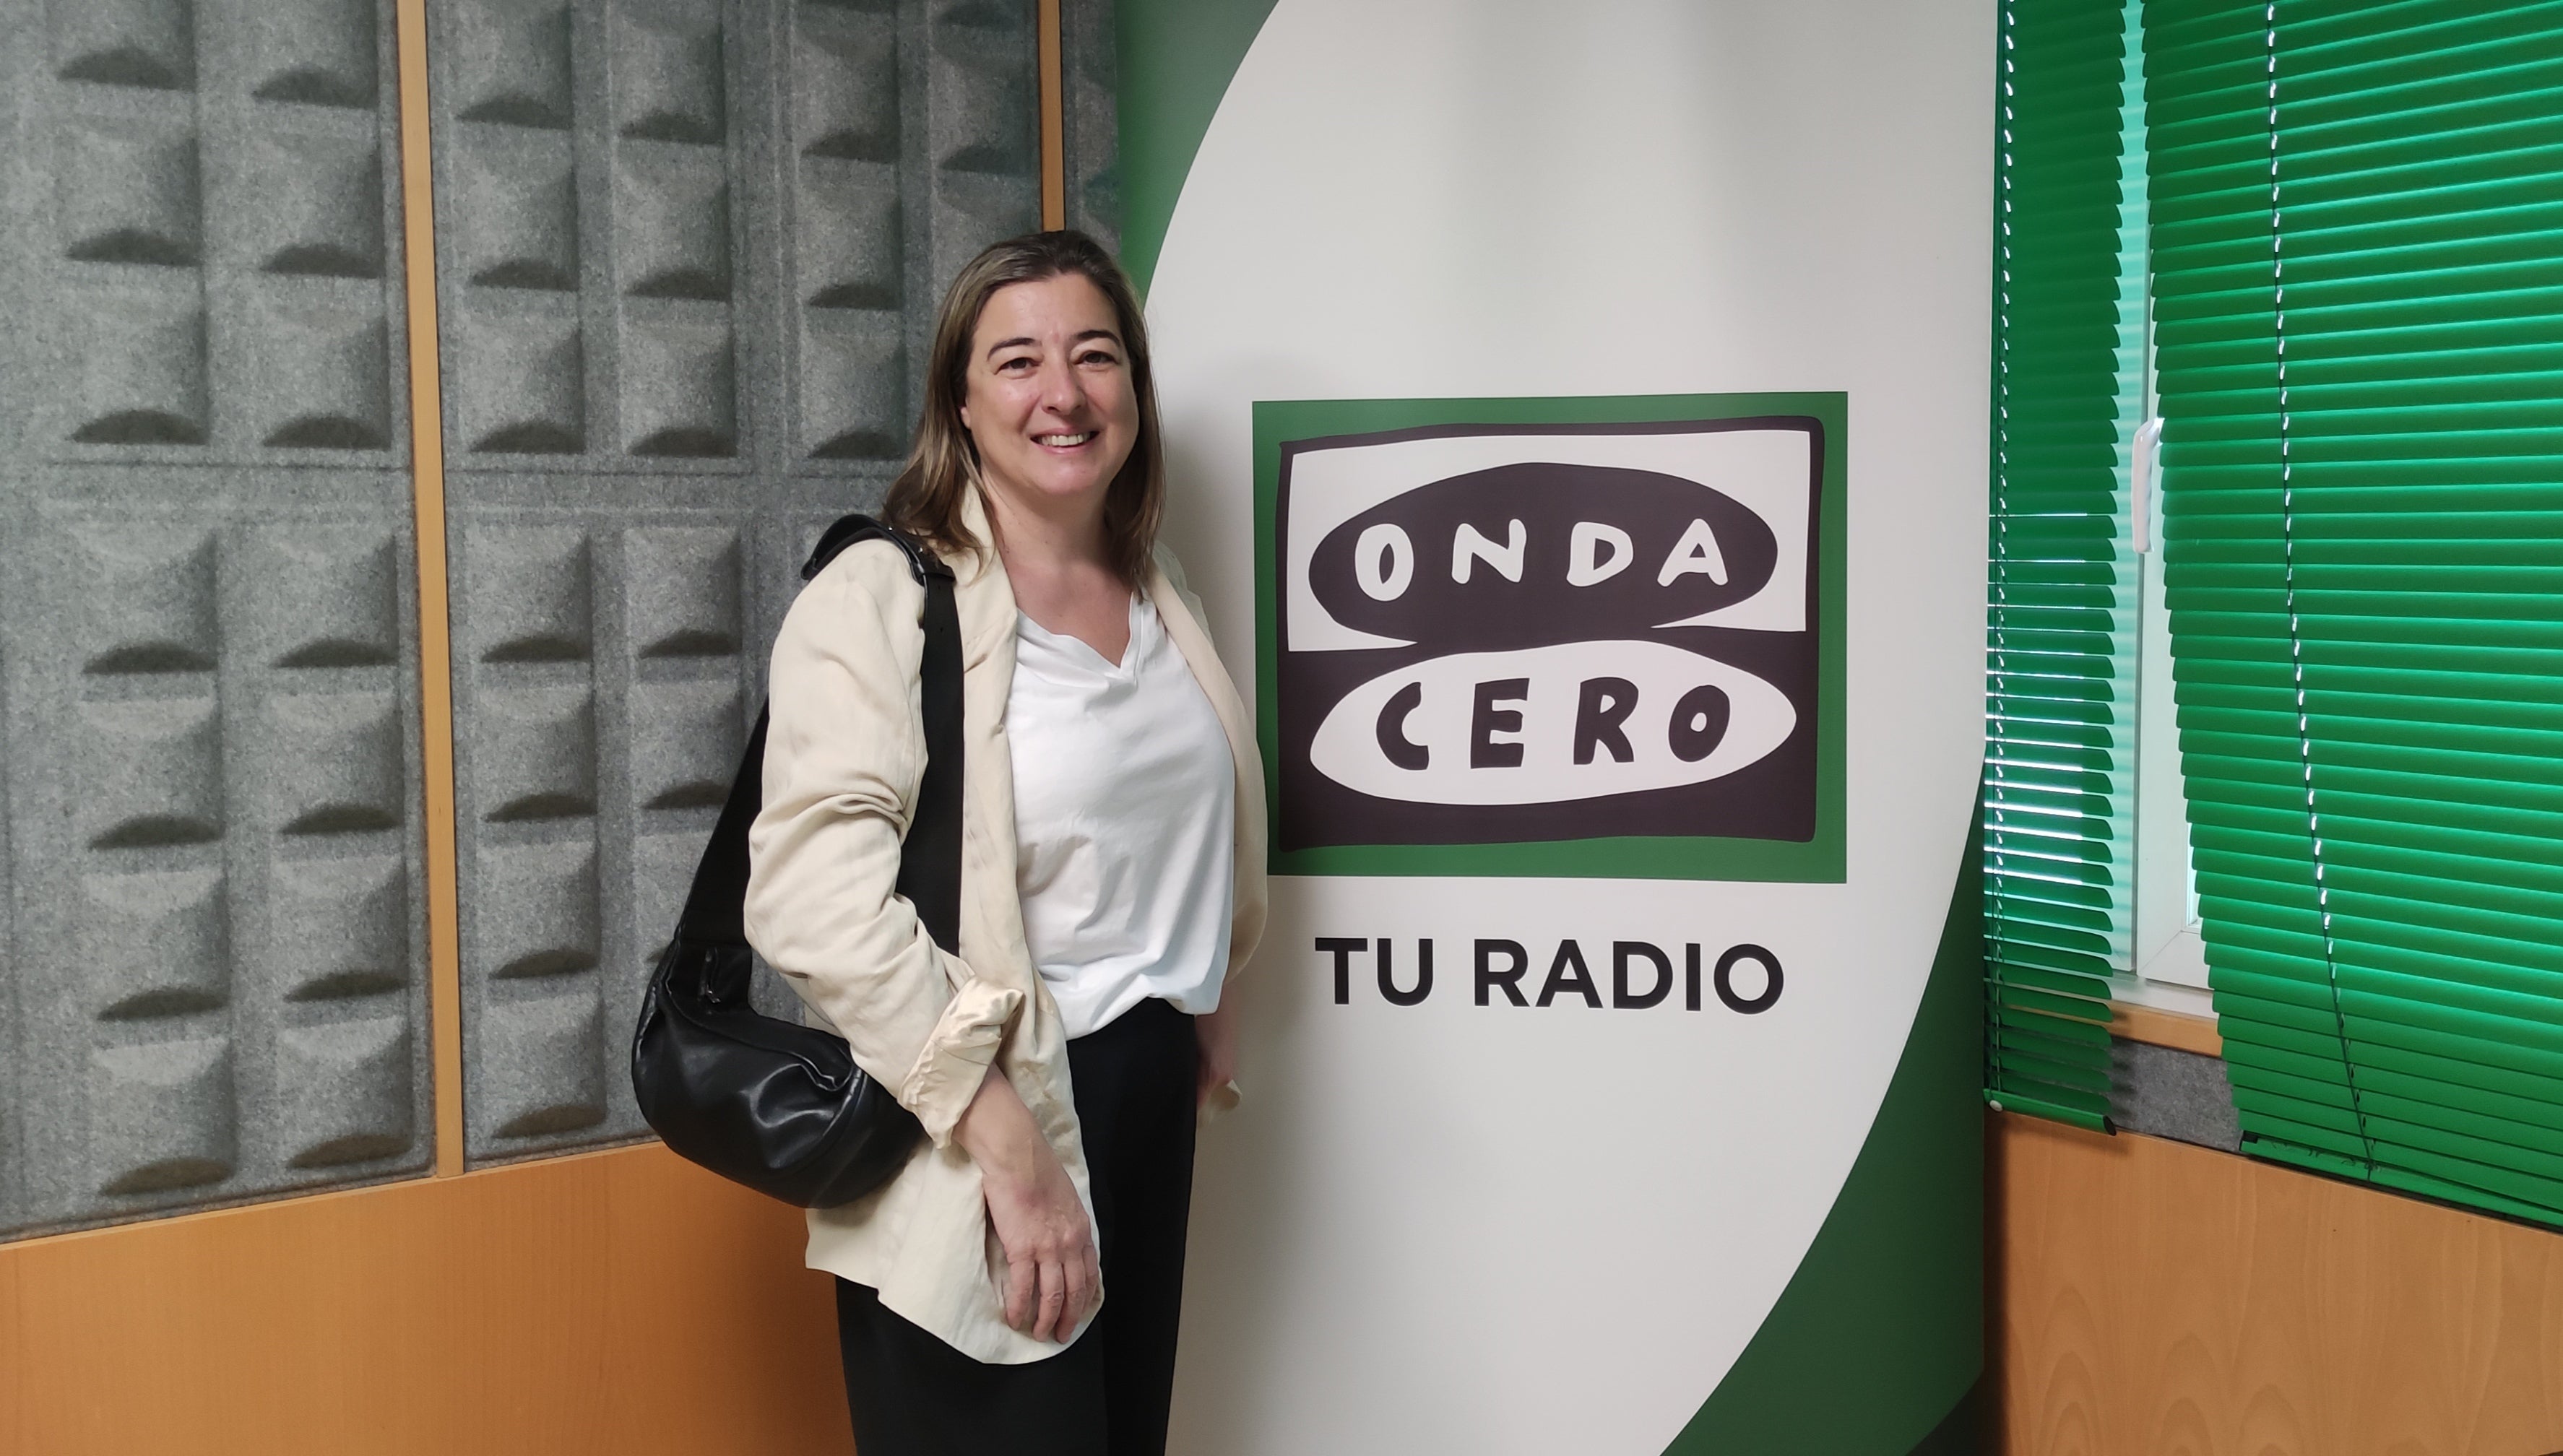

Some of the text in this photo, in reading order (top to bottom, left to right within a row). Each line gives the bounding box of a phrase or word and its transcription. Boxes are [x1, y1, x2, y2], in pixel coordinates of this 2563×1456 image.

[1354, 518, 1729, 602] ONDA
[1375, 676, 1731, 771] CERO
[1315, 937, 1785, 1015] TU RADIO
